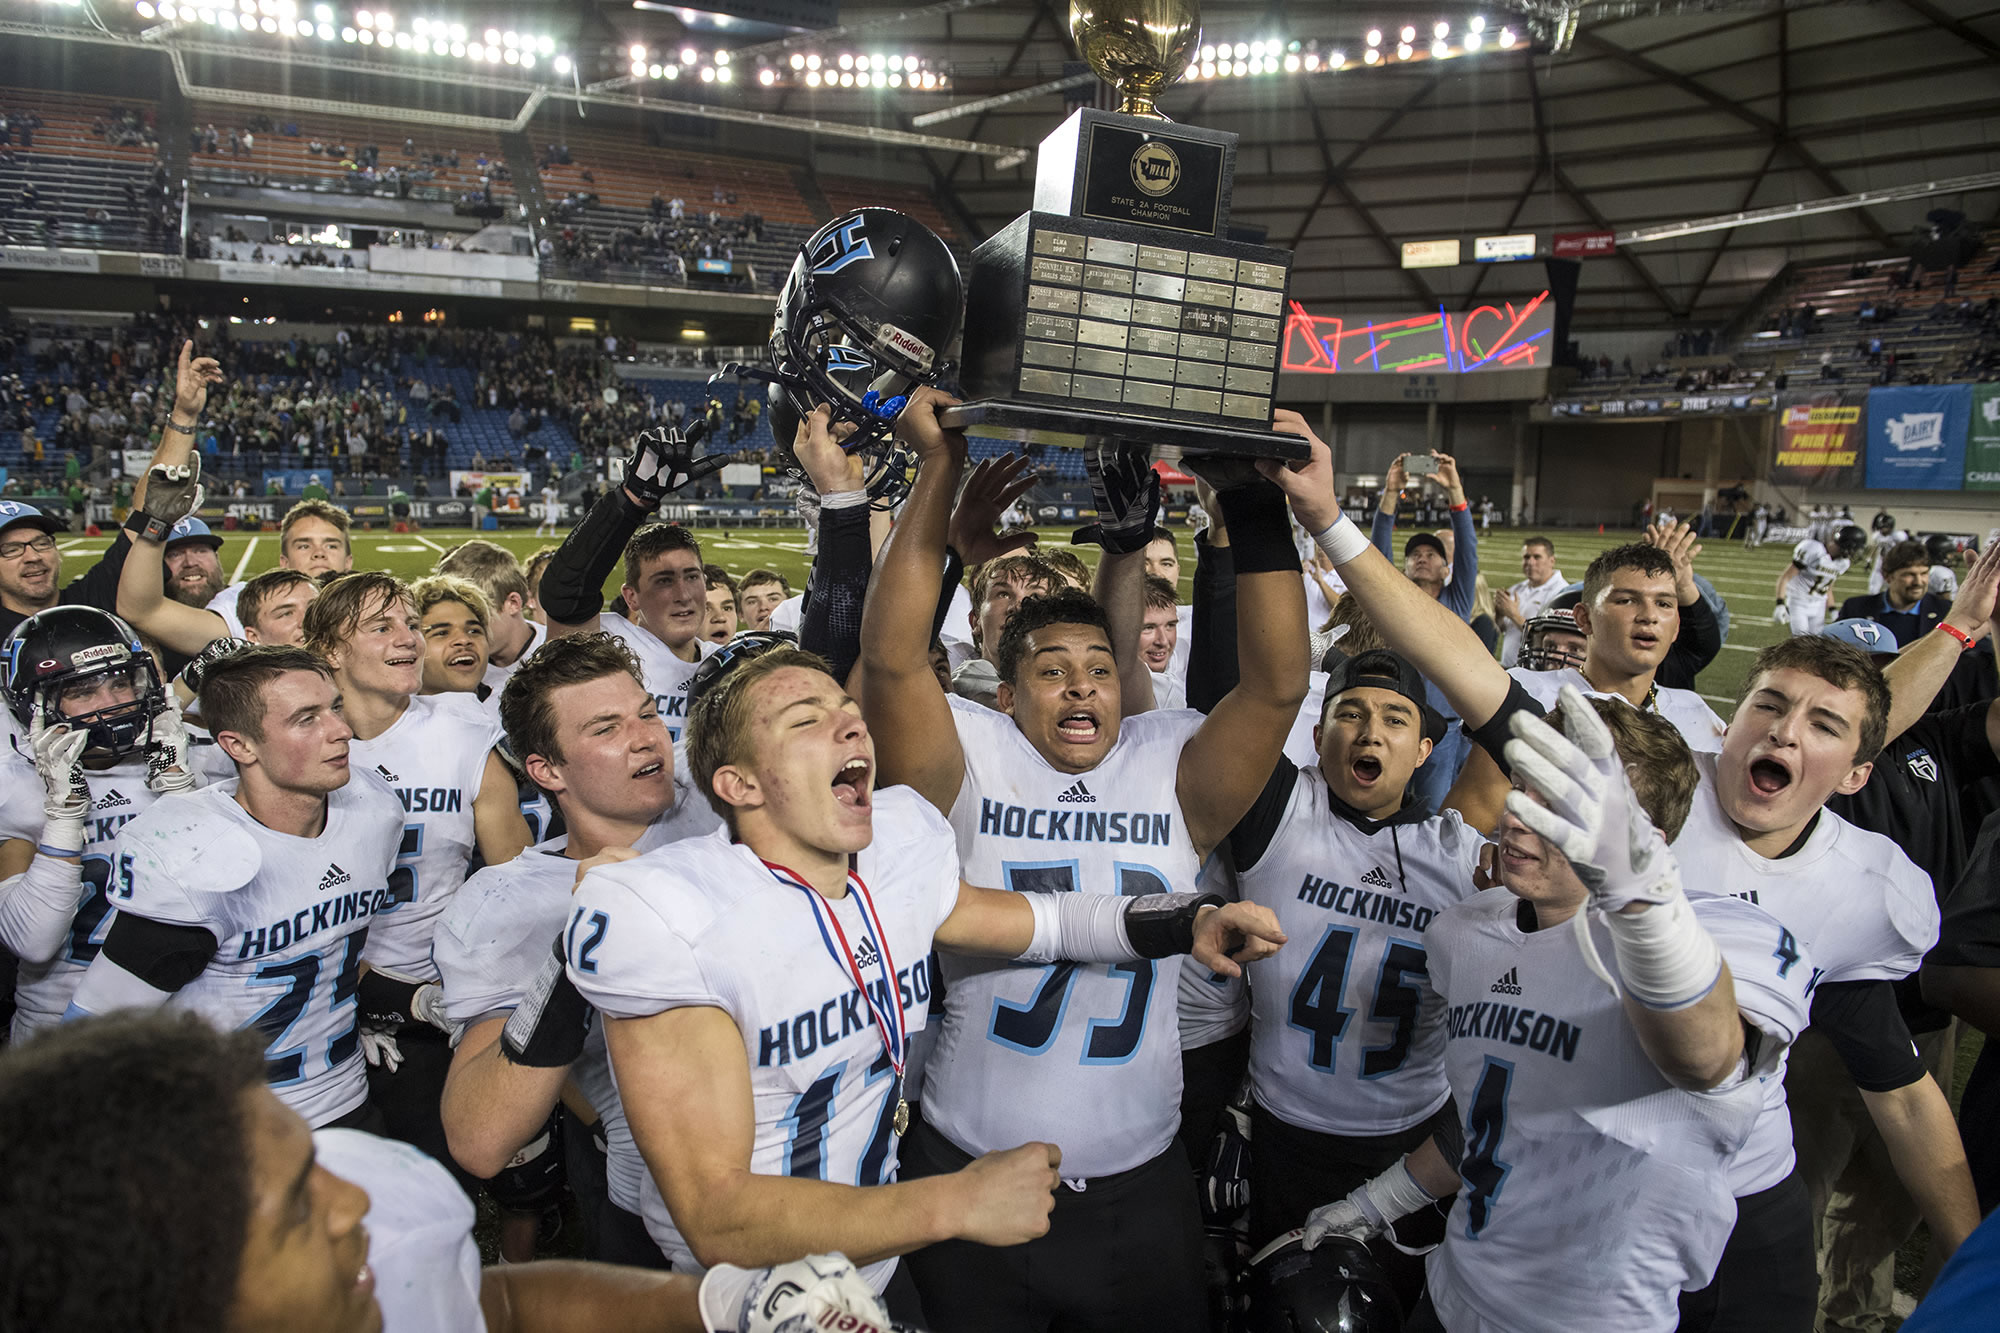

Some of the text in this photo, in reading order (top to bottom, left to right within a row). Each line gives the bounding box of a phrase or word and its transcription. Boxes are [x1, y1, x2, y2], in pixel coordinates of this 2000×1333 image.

[1111, 196, 1191, 216] STATE 2A FOOTBALL
[1131, 208, 1170, 220] CHAMPION
[1052, 238, 1067, 246] ELMA
[7, 252, 91, 267] Heritage Bank
[1038, 261, 1063, 272] CONNELL
[1040, 271, 1072, 282] EAGLES 2002
[1031, 315, 1073, 328] LYNDEN LIONS
[1236, 317, 1276, 329] LYNDEN LIONS
[892, 331, 924, 356] Riddell
[1404, 388, 1439, 398] EXIT
[1602, 401, 1625, 413] STATE
[1681, 398, 1709, 410] STATE
[1904, 418, 1938, 439] DAIRY
[1791, 433, 1846, 449] PRIDE IN
[1776, 451, 1858, 467] PERFORMANCE
[228, 503, 275, 521] STATE
[529, 503, 569, 519] STTE
[659, 504, 698, 520] STATE
[83, 644, 115, 660] Riddell
[97, 796, 131, 810] adidas
[1057, 794, 1096, 803] adidas
[980, 797, 1171, 846] HOCKINSON
[319, 873, 351, 891] adidas
[1360, 874, 1393, 890] adidas
[1297, 873, 1440, 933] HOCKINSO
[238, 889, 387, 959] HOCKINSO
[567, 906, 610, 975] 12
[1772, 924, 1801, 981] 4
[856, 953, 881, 969] dida
[1491, 983, 1522, 996] adidas
[1287, 922, 1431, 1080] 45
[758, 955, 932, 1067] HOCKINSO
[1460, 1053, 1516, 1241] 4
